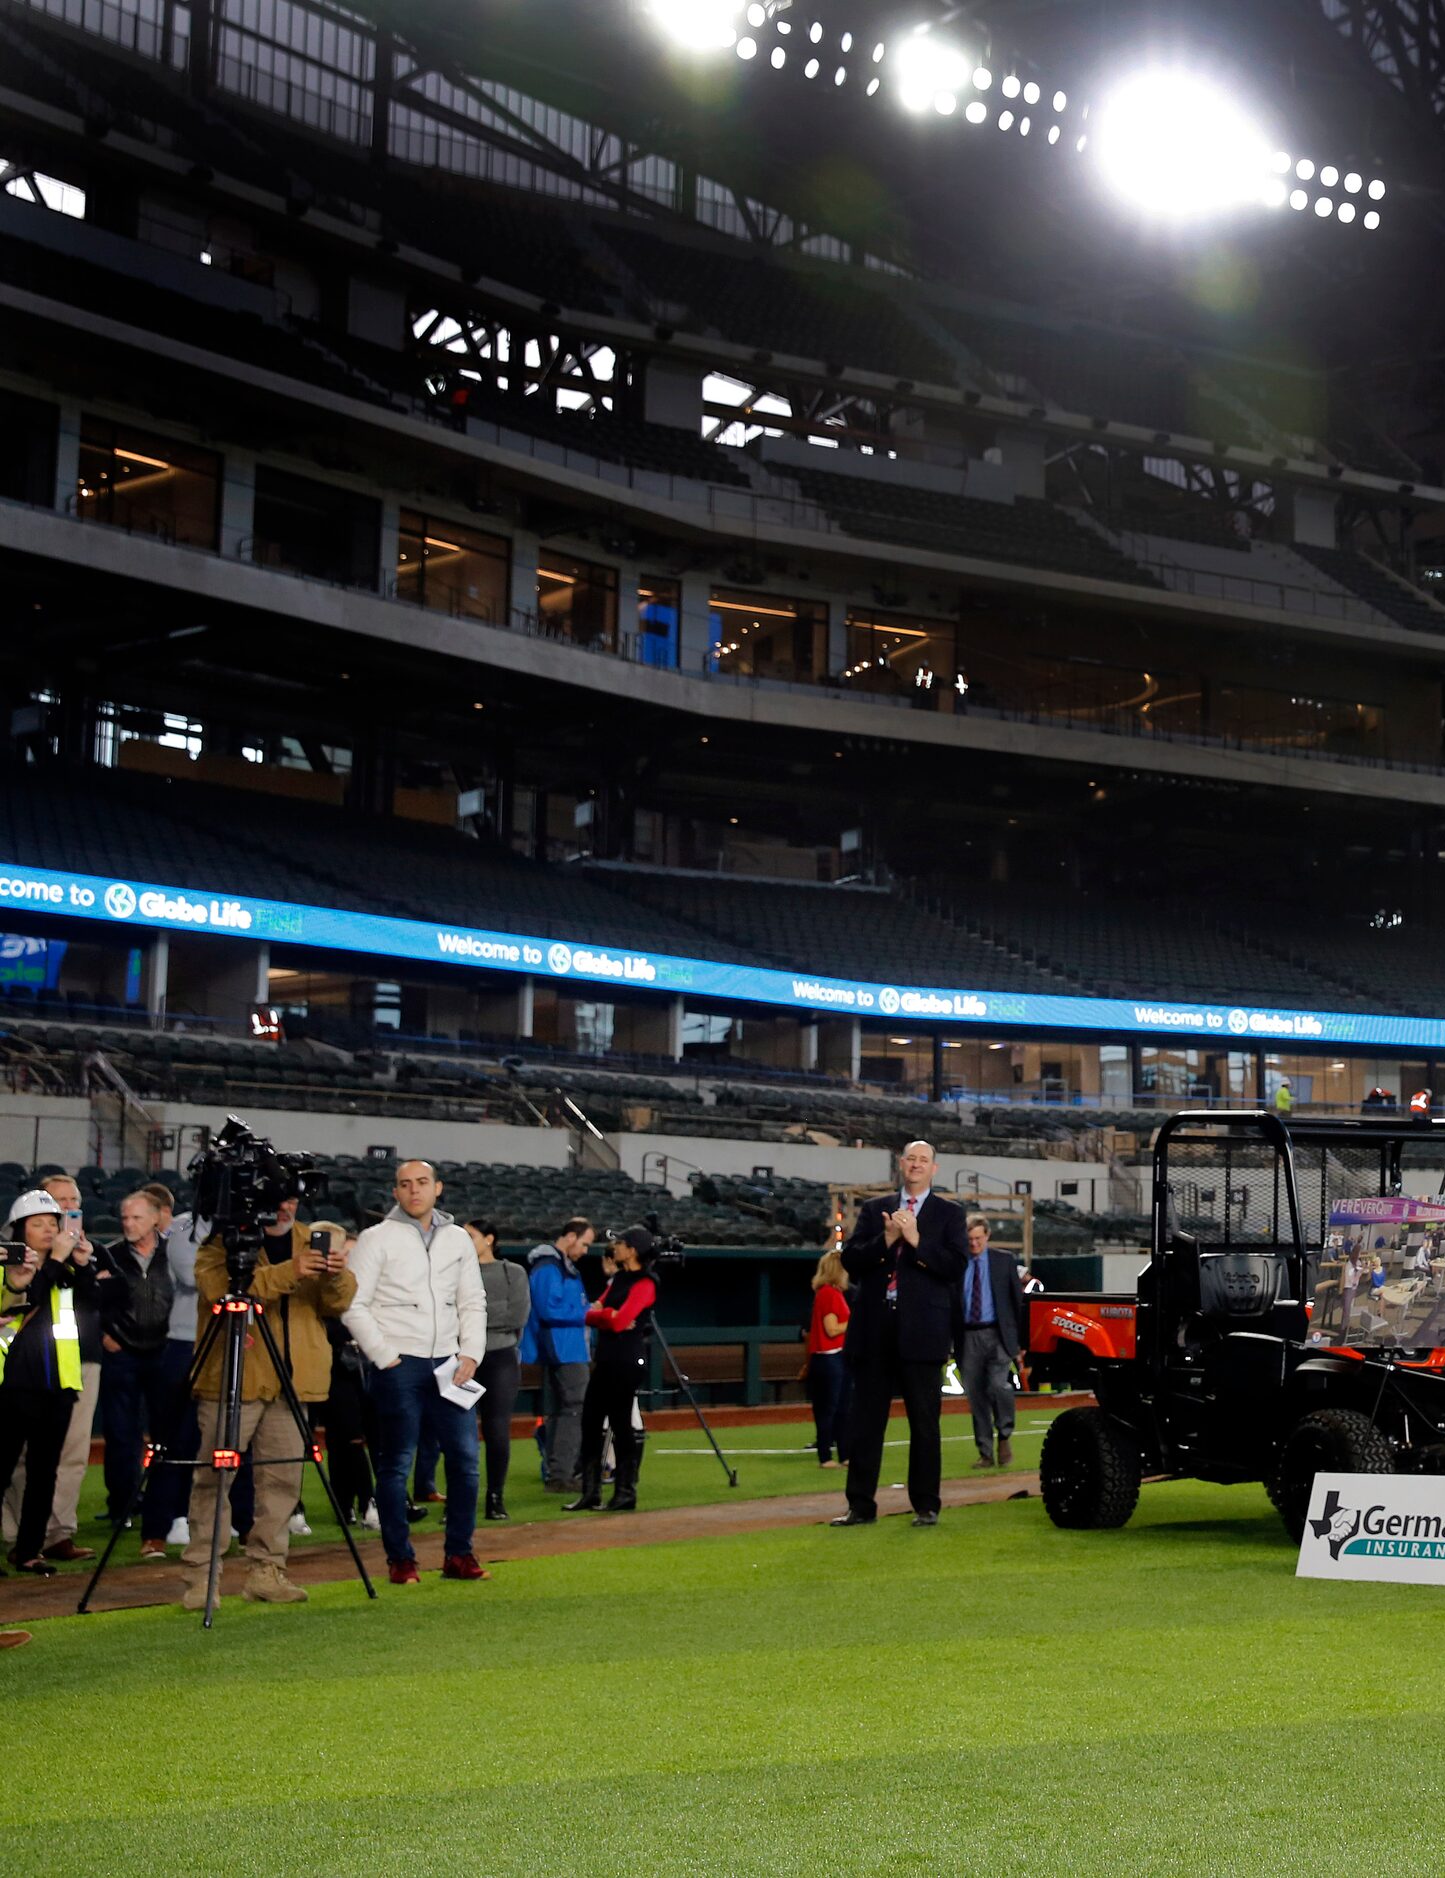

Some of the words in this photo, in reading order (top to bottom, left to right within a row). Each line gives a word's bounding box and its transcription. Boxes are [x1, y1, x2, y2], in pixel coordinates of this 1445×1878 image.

[70, 884, 95, 907] to
[139, 892, 208, 924] Globe
[210, 900, 252, 929] Life
[254, 907, 303, 935] Field
[437, 933, 520, 962] Welcome
[523, 945, 542, 965] to
[572, 951, 623, 978] Globe
[624, 957, 656, 981] Life
[792, 981, 855, 1006] Welcome
[857, 990, 874, 1007] to
[900, 992, 953, 1015] Globe
[954, 995, 987, 1016] Life
[1134, 1007, 1204, 1027] Welcome
[1206, 1012, 1223, 1028] to
[1249, 1013, 1293, 1034] Globe
[1294, 1015, 1323, 1036] Life
